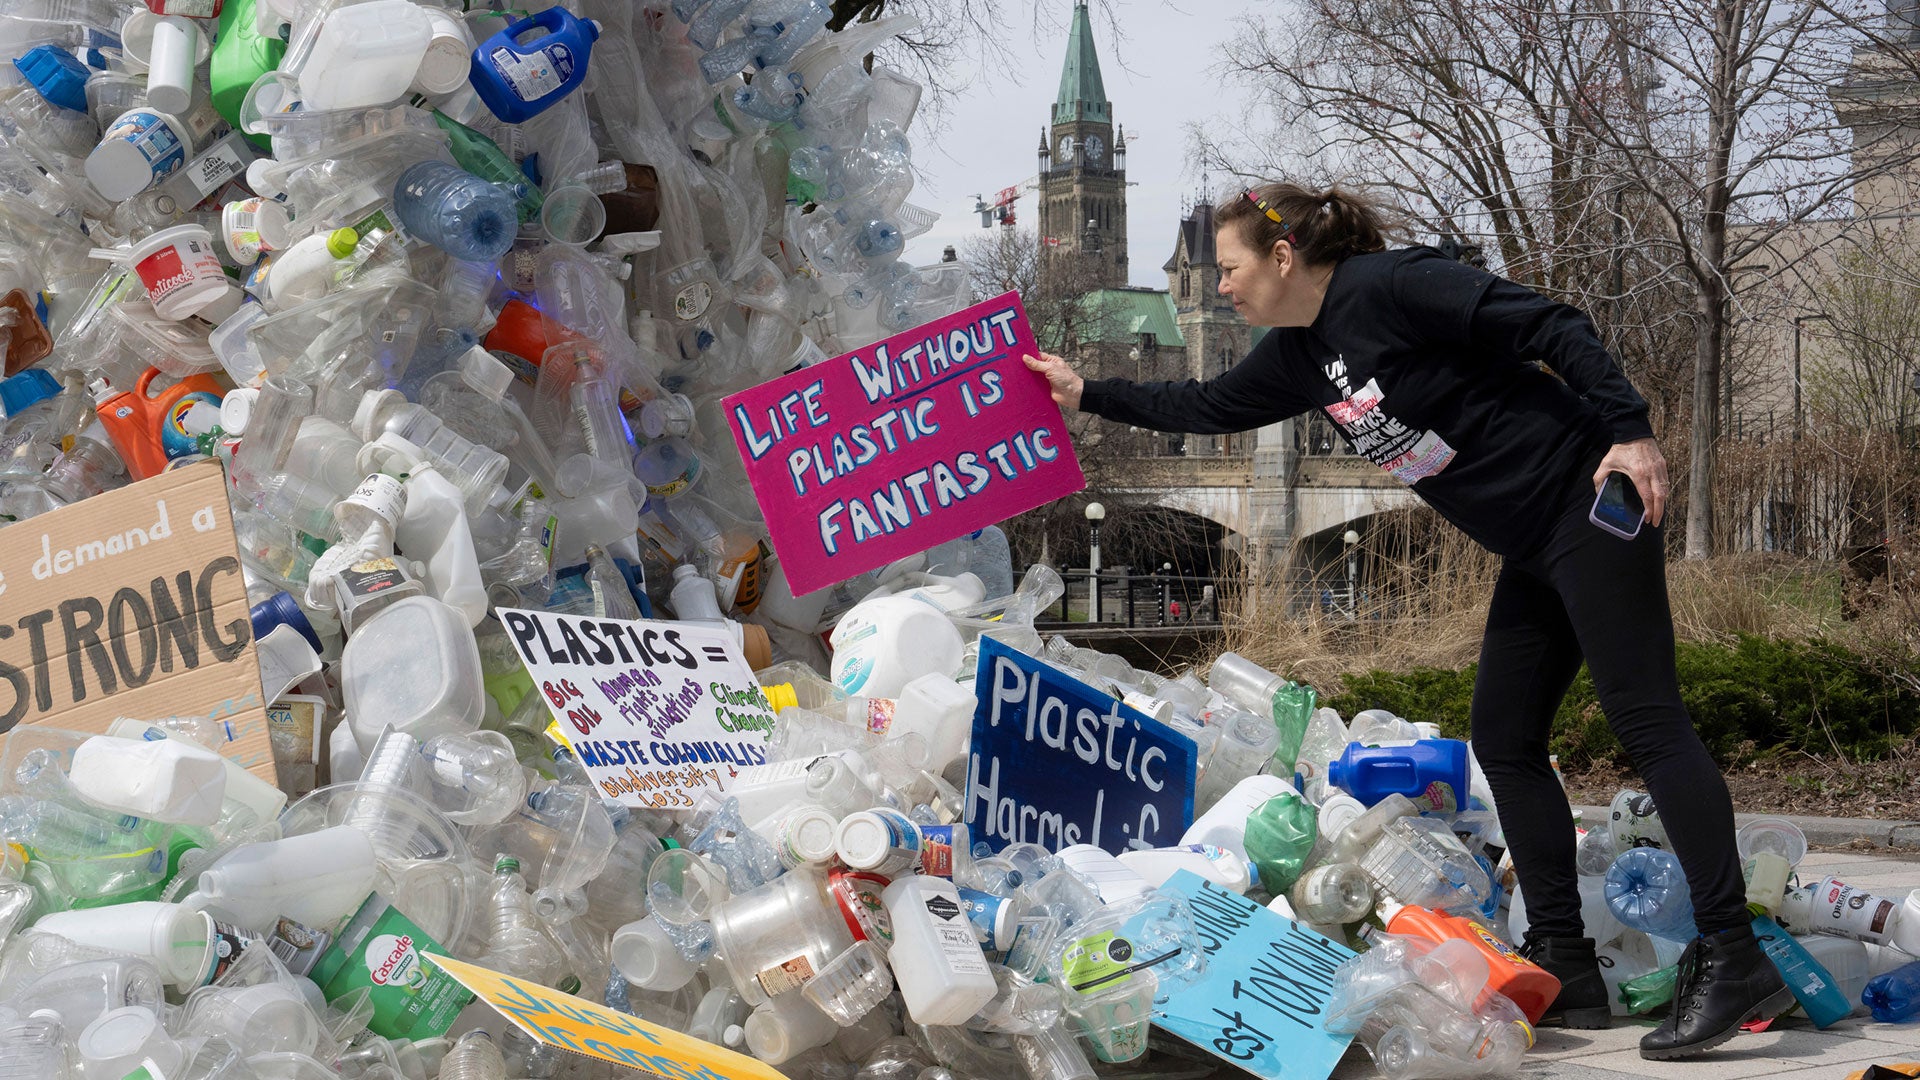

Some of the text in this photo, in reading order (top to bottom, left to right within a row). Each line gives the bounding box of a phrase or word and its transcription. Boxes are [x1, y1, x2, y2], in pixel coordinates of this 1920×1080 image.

[735, 307, 1018, 460] LIFE WITHOUT
[787, 369, 1004, 496] PLASTIC IS
[1381, 417, 1407, 437] ME
[818, 427, 1059, 556] FANTASTIC
[32, 500, 216, 580] demand a
[504, 612, 698, 669] PLASTICS
[542, 678, 584, 709] BIG
[592, 668, 662, 705] human
[618, 688, 659, 727] rights
[650, 678, 703, 740] violations
[709, 681, 773, 712] Climate
[568, 703, 602, 735] OIL
[715, 707, 777, 741] Change
[990, 656, 1167, 792] Plastic
[575, 740, 766, 768] WASTE COLONIALIS
[599, 764, 725, 798] biodiversity
[371, 934, 413, 985] Cascade
[1137, 932, 1181, 954] boston
[496, 978, 662, 1046] Just
[1212, 921, 1355, 1061] est TOXIQUE
